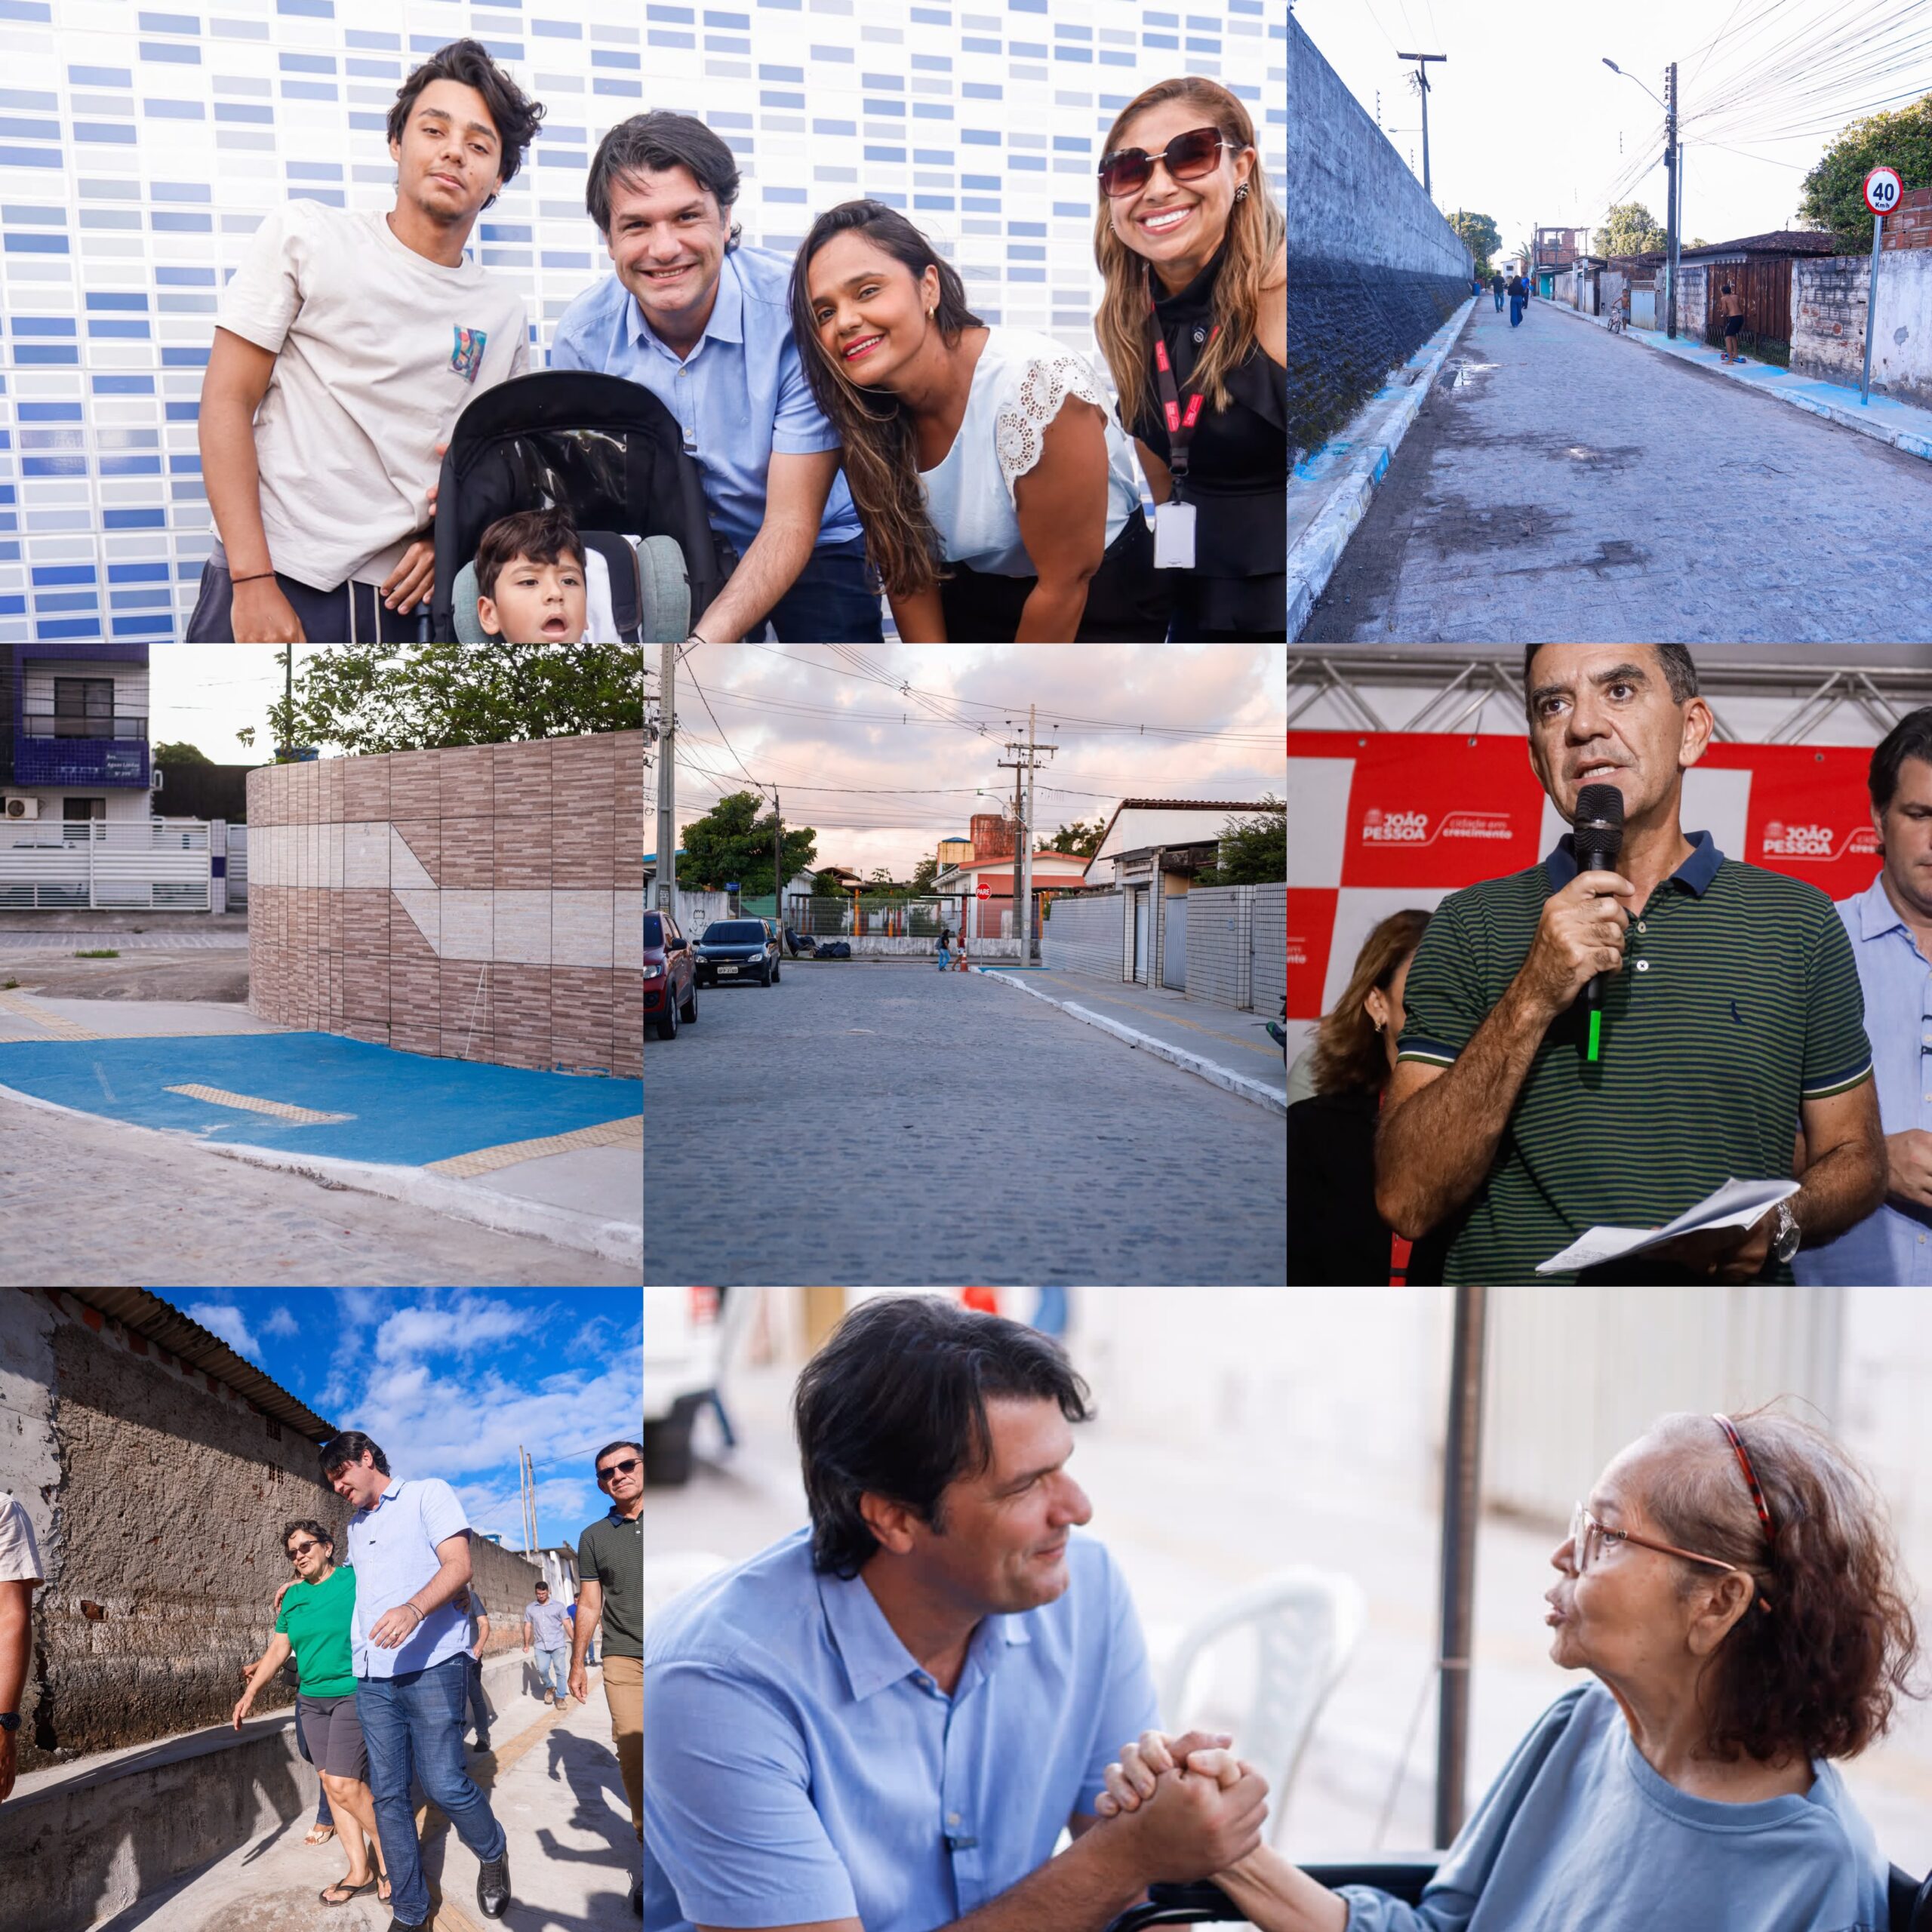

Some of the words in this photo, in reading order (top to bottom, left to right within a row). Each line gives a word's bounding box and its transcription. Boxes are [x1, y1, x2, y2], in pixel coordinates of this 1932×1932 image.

[1873, 183, 1894, 201] 40
[1384, 811, 1428, 827] JOÃO
[1487, 821, 1508, 829] em
[1363, 826, 1426, 841] PESSOA
[1442, 828, 1513, 839] crescimento
[1786, 825, 1833, 841] JOÃO
[1763, 839, 1832, 855] PESSOA
